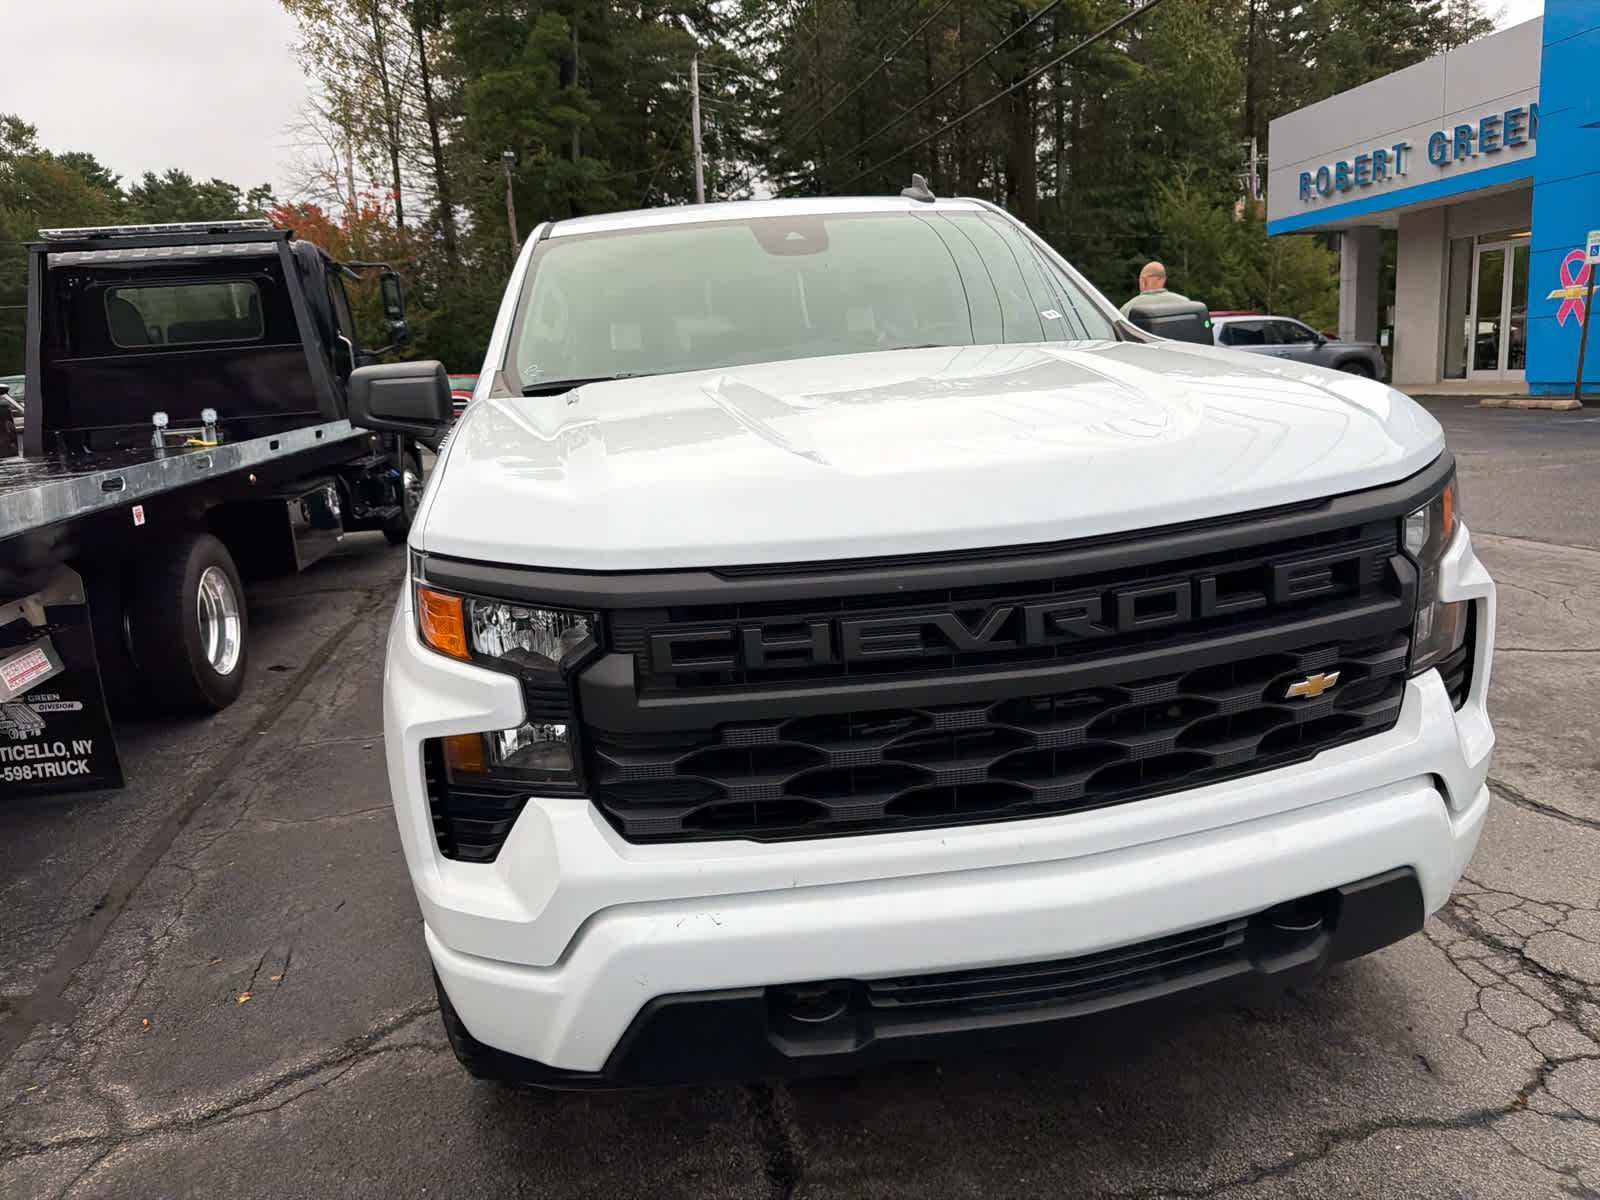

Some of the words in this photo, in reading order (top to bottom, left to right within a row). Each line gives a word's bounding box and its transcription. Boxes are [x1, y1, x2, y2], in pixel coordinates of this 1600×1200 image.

[1298, 142, 1411, 202] ROBERT
[647, 545, 1387, 673] CHEVROLET
[27, 693, 60, 702] GREEN
[38, 702, 74, 711] DIVISION
[72, 739, 93, 755] NY
